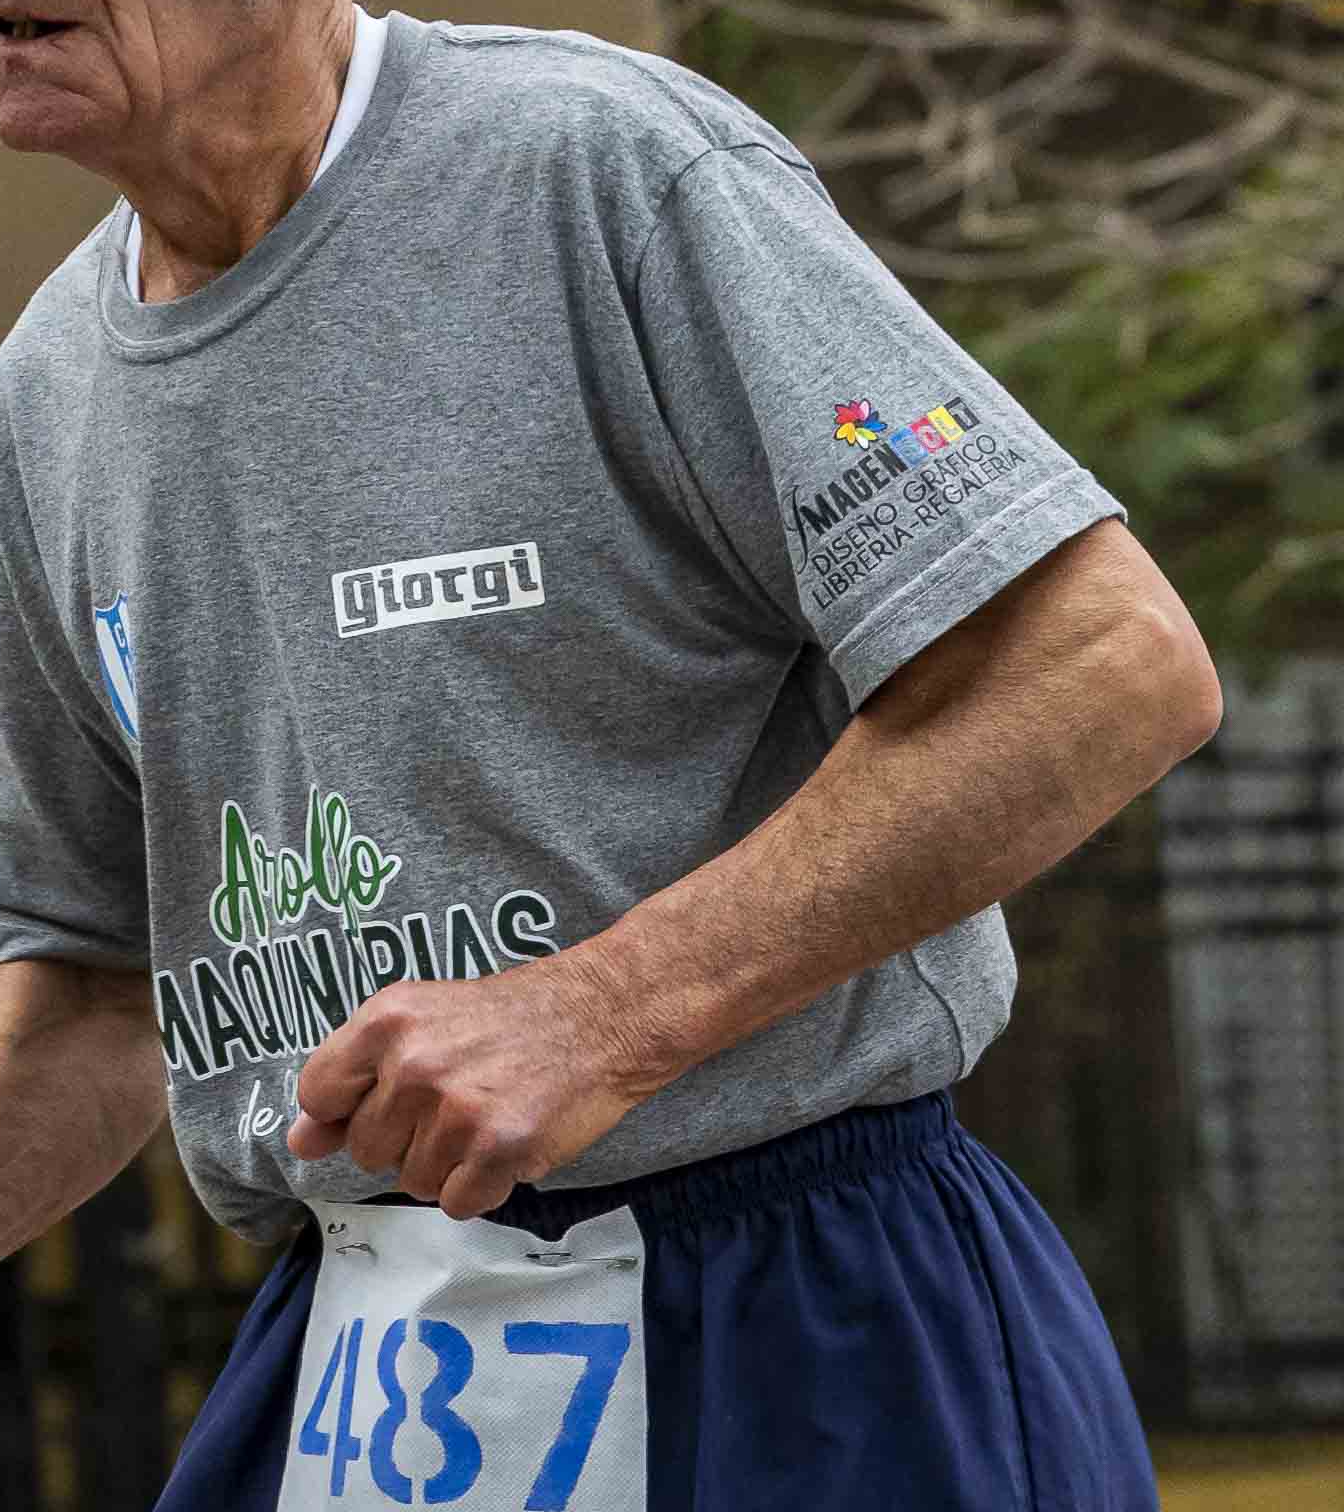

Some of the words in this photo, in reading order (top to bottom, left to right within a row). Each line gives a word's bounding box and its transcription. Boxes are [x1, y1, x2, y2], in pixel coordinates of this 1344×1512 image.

[784, 442, 908, 576] IMAGEN
[903, 433, 996, 504] GRÁFICO
[340, 547, 539, 634] giorgi
[238, 1079, 285, 1143] de
[297, 1317, 632, 1512] 487
